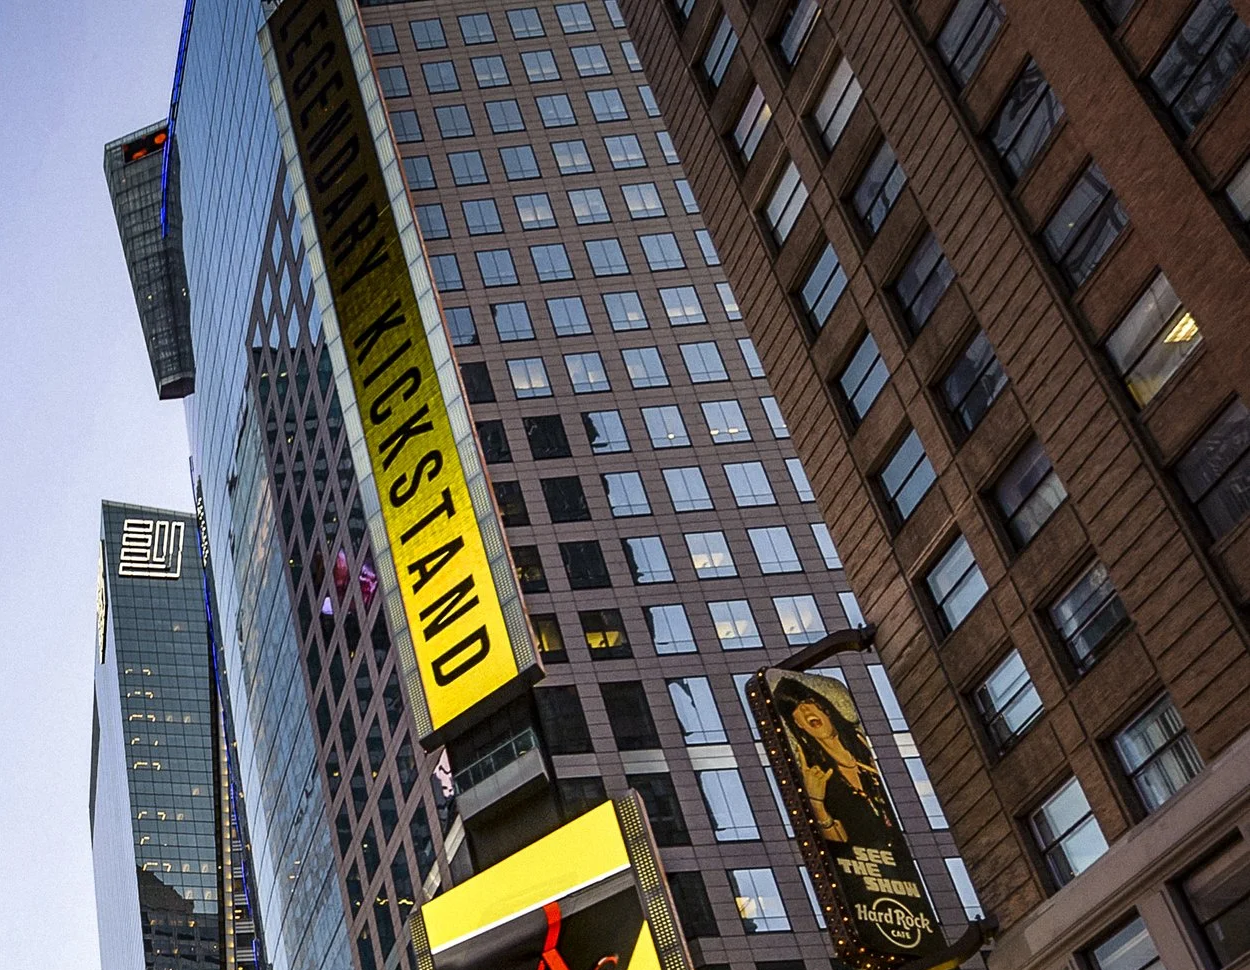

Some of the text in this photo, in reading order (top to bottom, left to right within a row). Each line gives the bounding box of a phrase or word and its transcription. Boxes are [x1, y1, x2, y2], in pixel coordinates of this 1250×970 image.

[280, 0, 490, 688] LEGENDARY KICKSTAND
[853, 847, 896, 866] SEE
[838, 858, 881, 878] THE
[863, 876, 921, 898] SHOW
[855, 903, 933, 934] Hard Rock
[891, 929, 911, 940] CAFE
